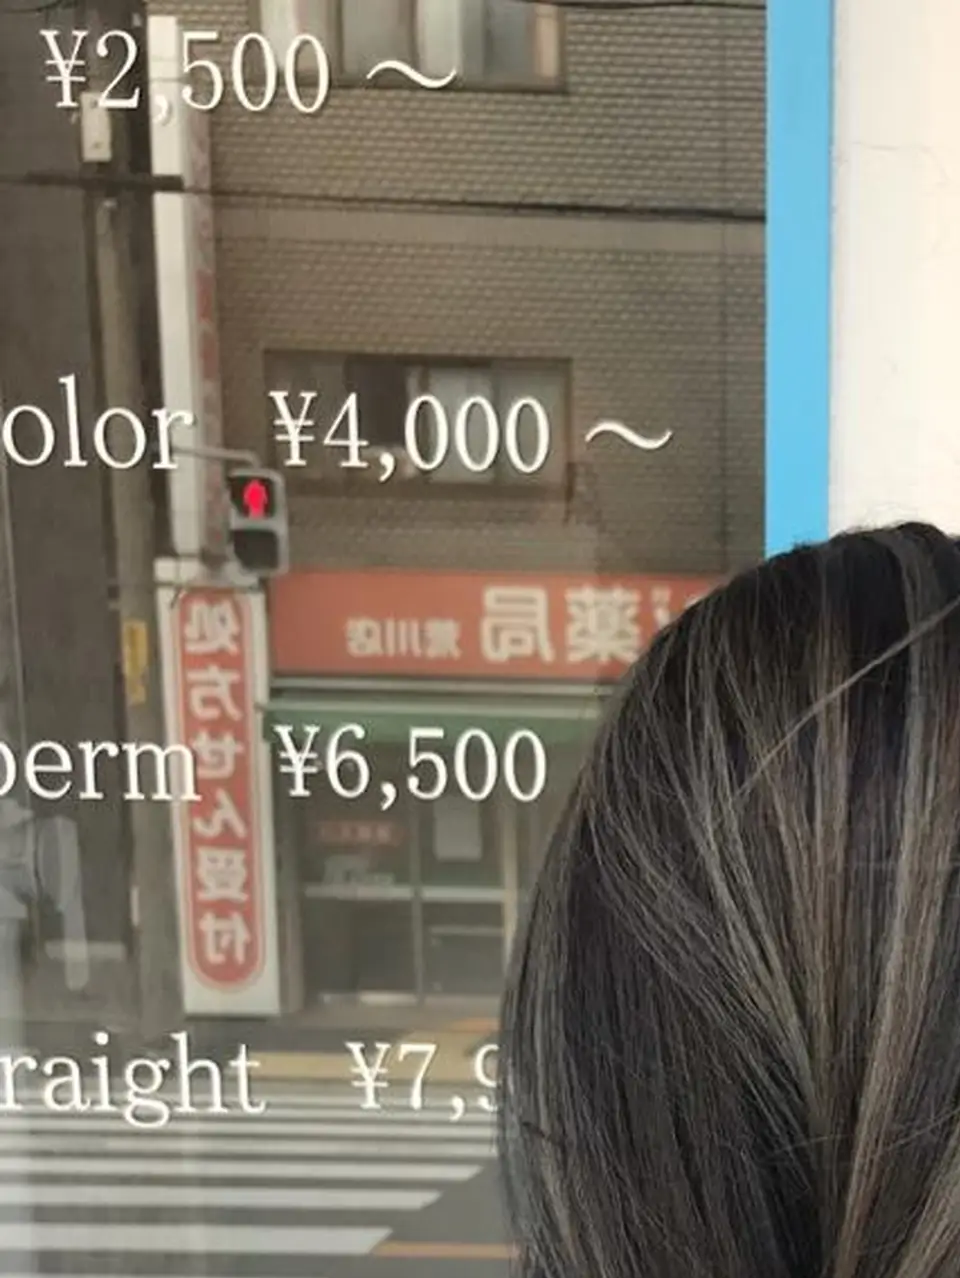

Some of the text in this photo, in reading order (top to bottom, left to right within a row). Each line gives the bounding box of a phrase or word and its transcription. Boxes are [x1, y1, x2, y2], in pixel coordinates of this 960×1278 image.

[40, 29, 330, 124] ¥2,500
[2, 373, 194, 469] olor
[268, 391, 550, 482] ¥4,000
[275, 725, 547, 810] ¥6,500
[0, 1031, 267, 1128] raight
